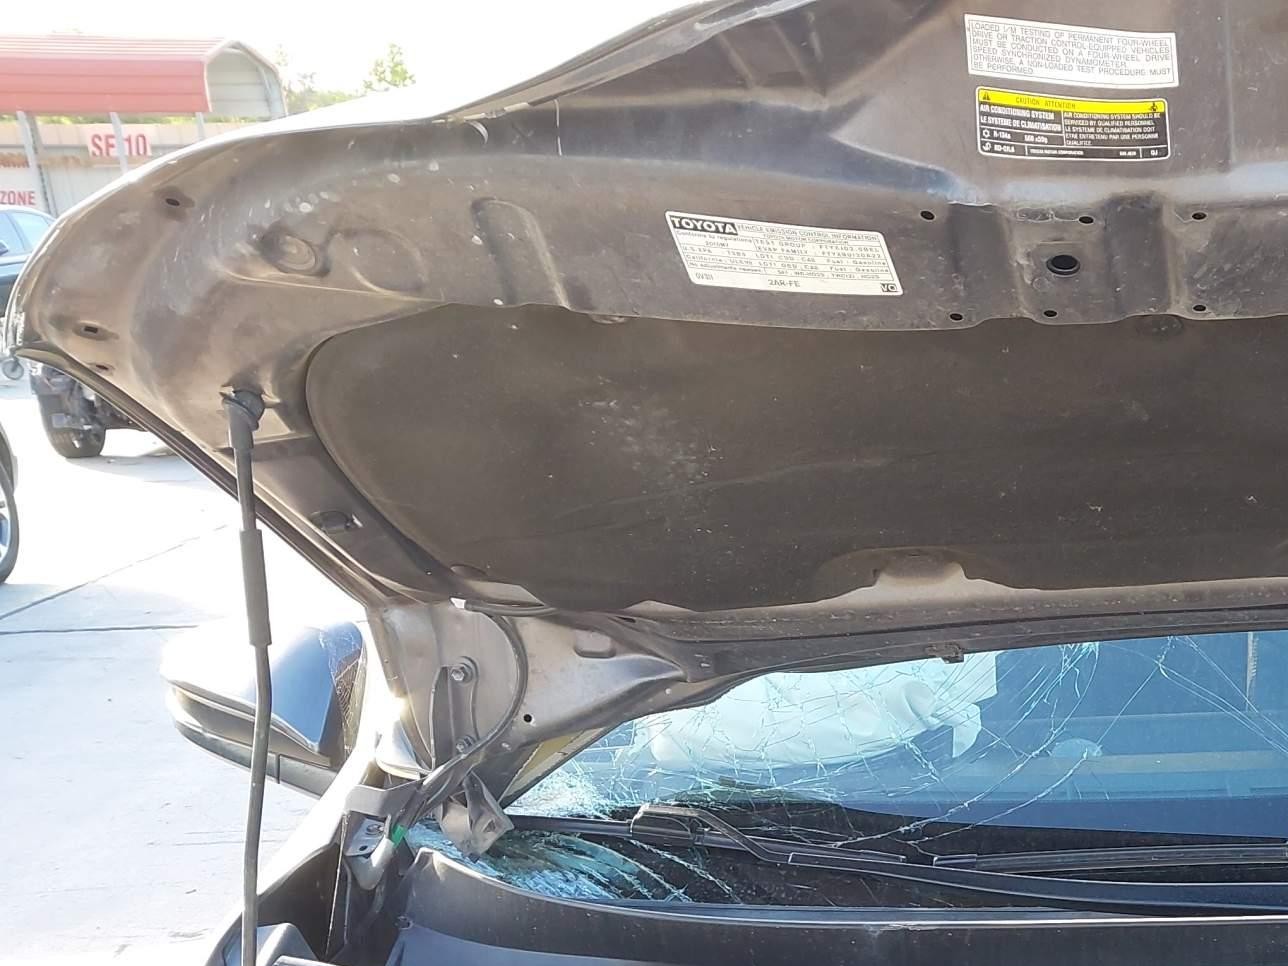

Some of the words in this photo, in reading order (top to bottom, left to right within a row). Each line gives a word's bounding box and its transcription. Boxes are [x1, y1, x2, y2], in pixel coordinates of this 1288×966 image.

[972, 22, 1000, 32] LOADED
[1020, 28, 1051, 38] TESTING
[1054, 31, 1065, 39] OF
[1068, 32, 1114, 44] PERMANENT
[972, 31, 993, 40] DRIVE
[1011, 35, 1048, 45] TRACTION
[1051, 38, 1086, 49] CONTROL
[1089, 42, 1127, 53] EQUIPPED
[973, 39, 992, 47] MUST
[1011, 43, 1058, 54] CONDUCTED
[1062, 47, 1074, 56] ON
[1145, 54, 1170, 62] DRIVE
[973, 46, 998, 55] SPEED
[1001, 49, 1061, 62] SYNCHRONIZED
[1077, 65, 1096, 74] TEST
[1099, 67, 1147, 76] PROCEDURE
[1150, 67, 1171, 76] MUST
[1015, 96, 1040, 105] CAUTION
[980, 104, 990, 112] AIR
[990, 105, 1030, 118] CONDITIONING
[1031, 110, 1055, 120] SYSTEM
[0, 190, 36, 206] ZONE
[670, 217, 737, 234] TOYOTA
[738, 223, 763, 231] VEHICLE
[765, 227, 797, 235] EMISSION
[800, 229, 828, 238] CONTROL
[831, 232, 879, 240] INFORMATION
[767, 279, 800, 288] 2AR-FE
